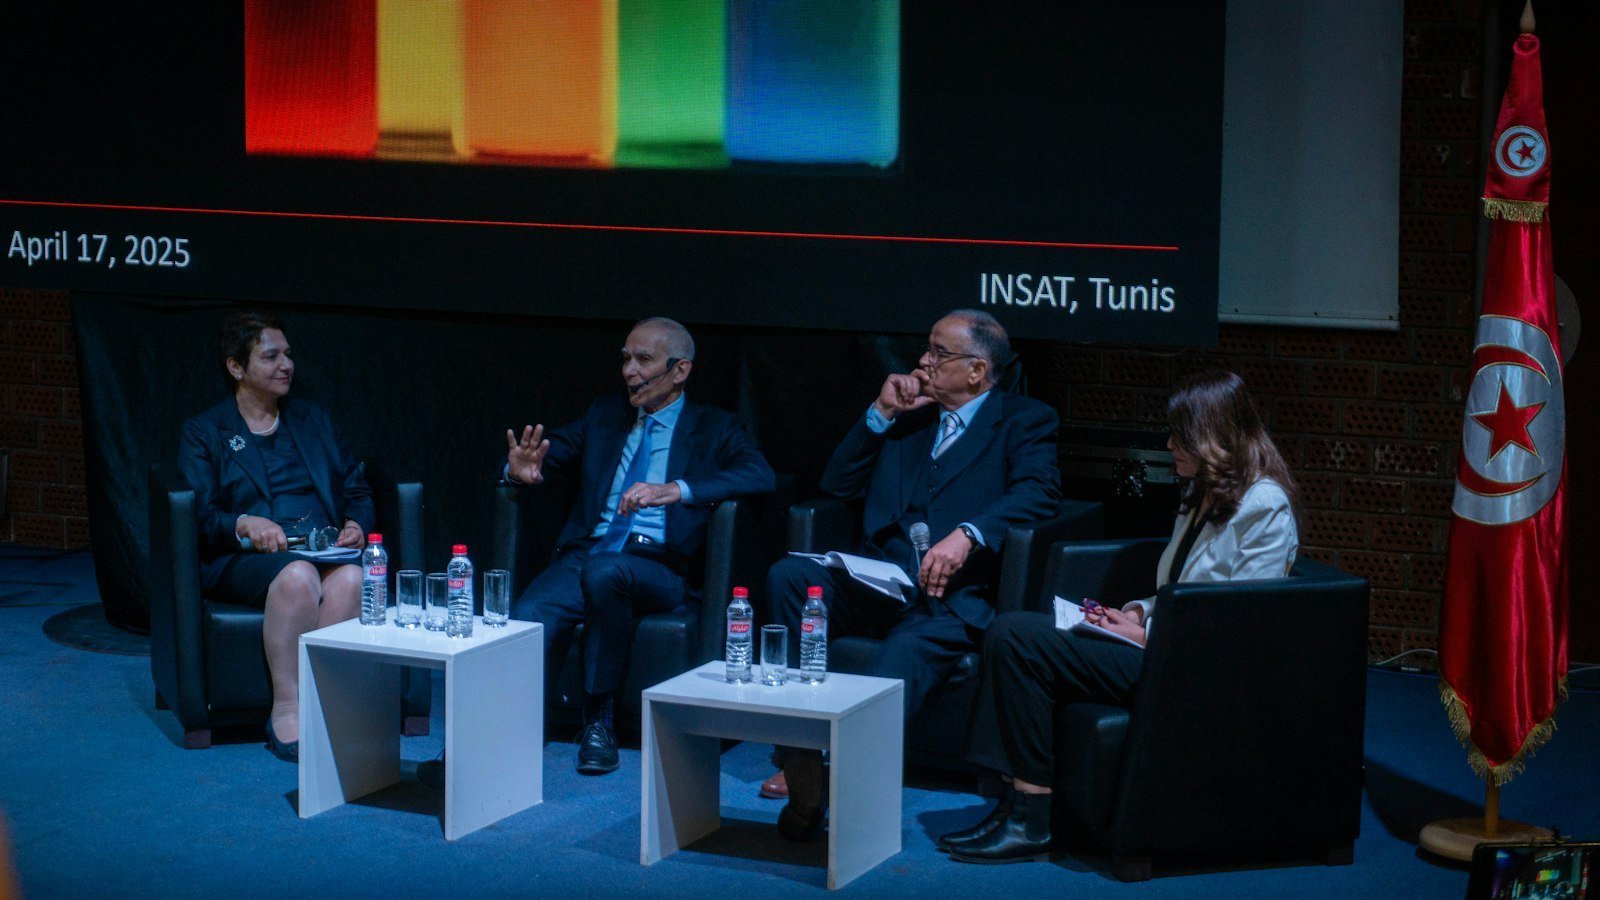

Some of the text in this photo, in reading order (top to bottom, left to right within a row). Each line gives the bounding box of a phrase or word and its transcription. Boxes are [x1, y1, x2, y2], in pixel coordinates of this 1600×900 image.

[8, 230, 191, 269] April 17, 2025
[980, 272, 1175, 314] INSAT, Tunis
